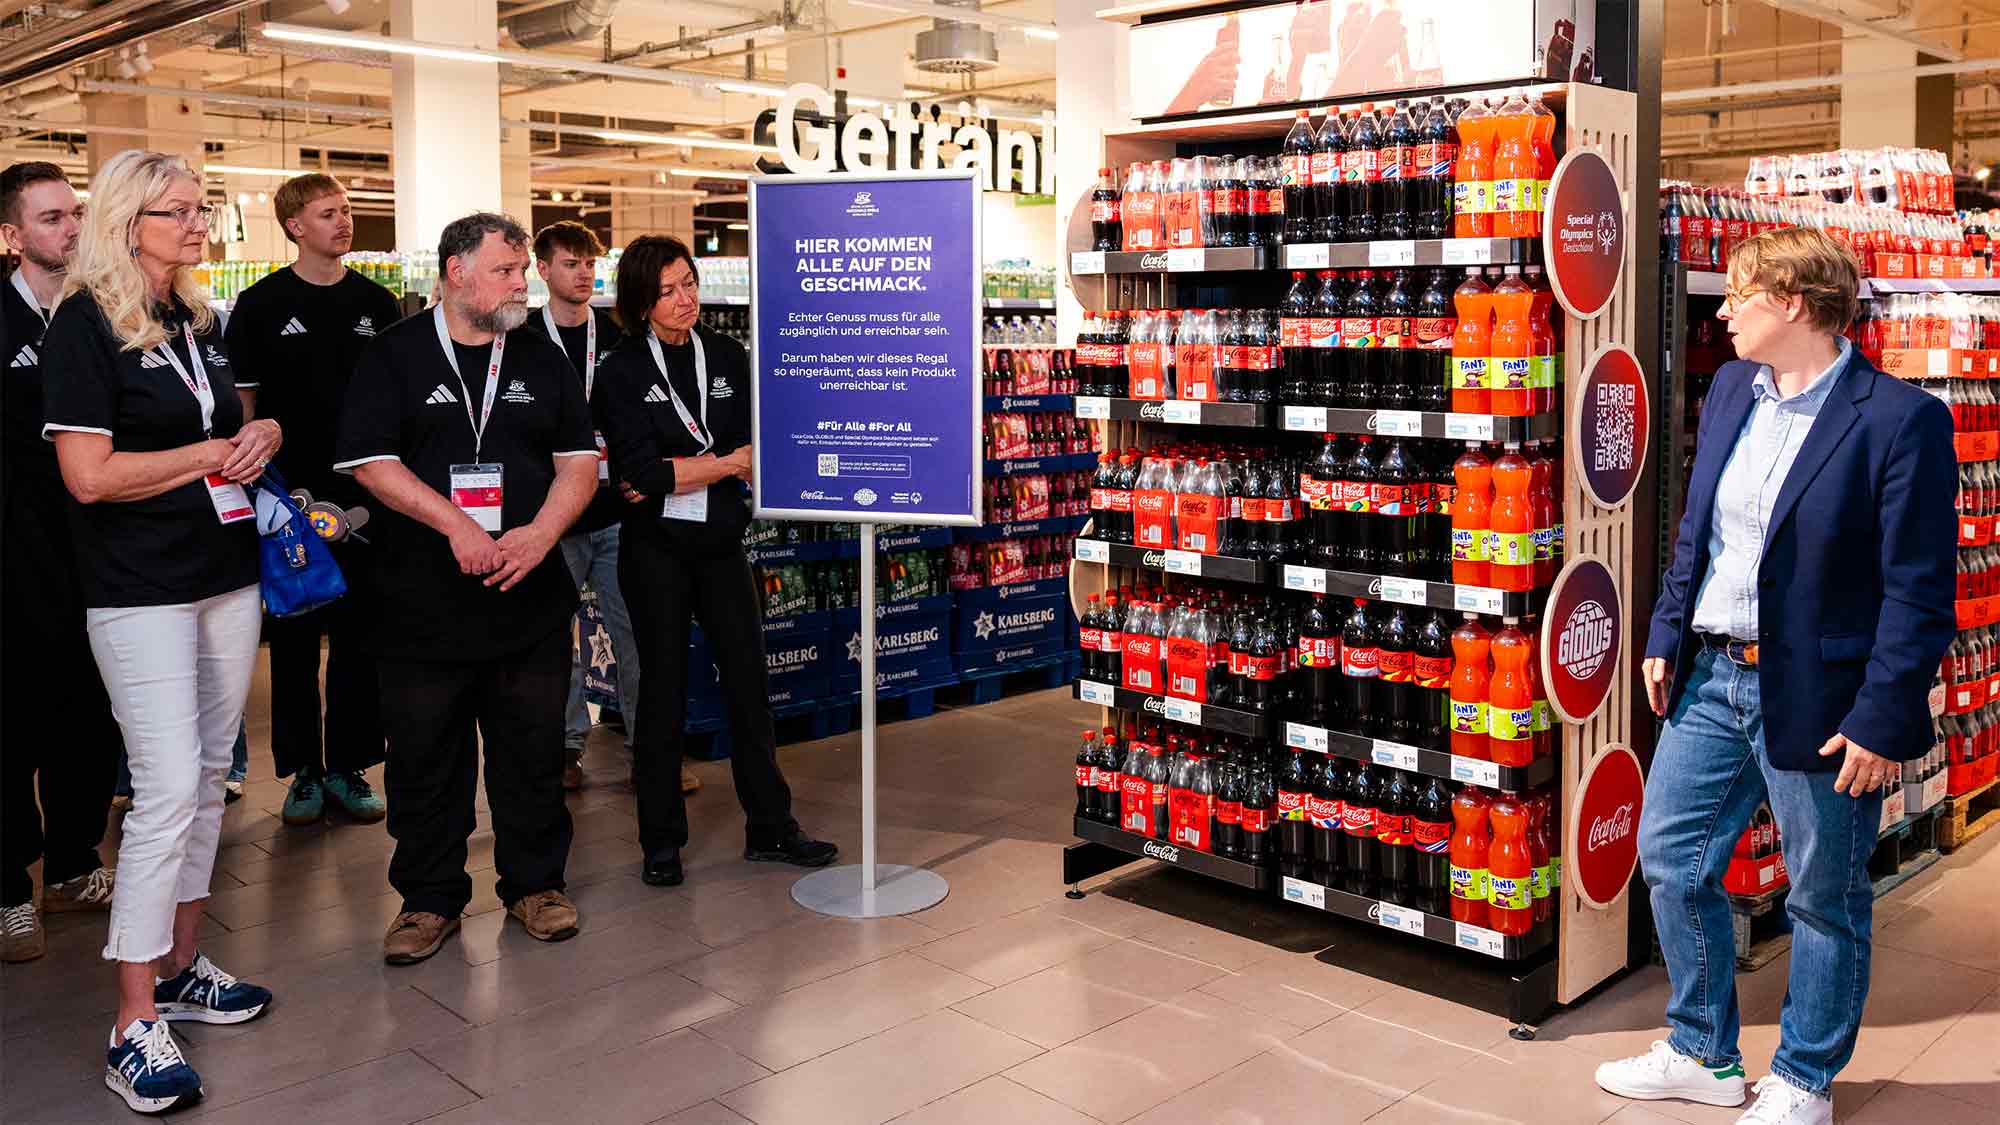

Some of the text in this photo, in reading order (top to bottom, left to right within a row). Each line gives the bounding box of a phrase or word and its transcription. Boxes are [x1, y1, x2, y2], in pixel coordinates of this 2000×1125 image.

[1567, 214, 1594, 226] Special
[1560, 227, 1594, 241] Olympics
[795, 236, 932, 254] HIER KOMMEN
[1562, 240, 1594, 253] Deutschland
[796, 256, 931, 273] ALLE AUF DEN
[801, 276, 926, 292] GESCHMACK.
[788, 311, 941, 322] Echter Genuss muss für alle
[779, 325, 950, 337] zugänglich und erreichbar sein.
[781, 353, 948, 365] Darum haben wir dieses Regal
[789, 367, 854, 378] eingeräumt,
[856, 367, 883, 377] dass
[885, 367, 908, 377] kein
[911, 368, 956, 377] Produkt
[820, 381, 908, 391] unerreichbar ist.
[817, 421, 912, 432] #Für Alle #For All
[997, 608, 1055, 629] KARLSBERG
[873, 626, 938, 651] KARLSBERG
[766, 646, 818, 667] RLSBERG
[1350, 650, 1378, 663] Coca-C
[1453, 704, 1478, 714] FANTA
[1511, 711, 1531, 722] FANT
[1588, 804, 1633, 852] Coca-Cola
[1144, 840, 1178, 862] Coca-Cola
[1491, 878, 1517, 889] FANTA
